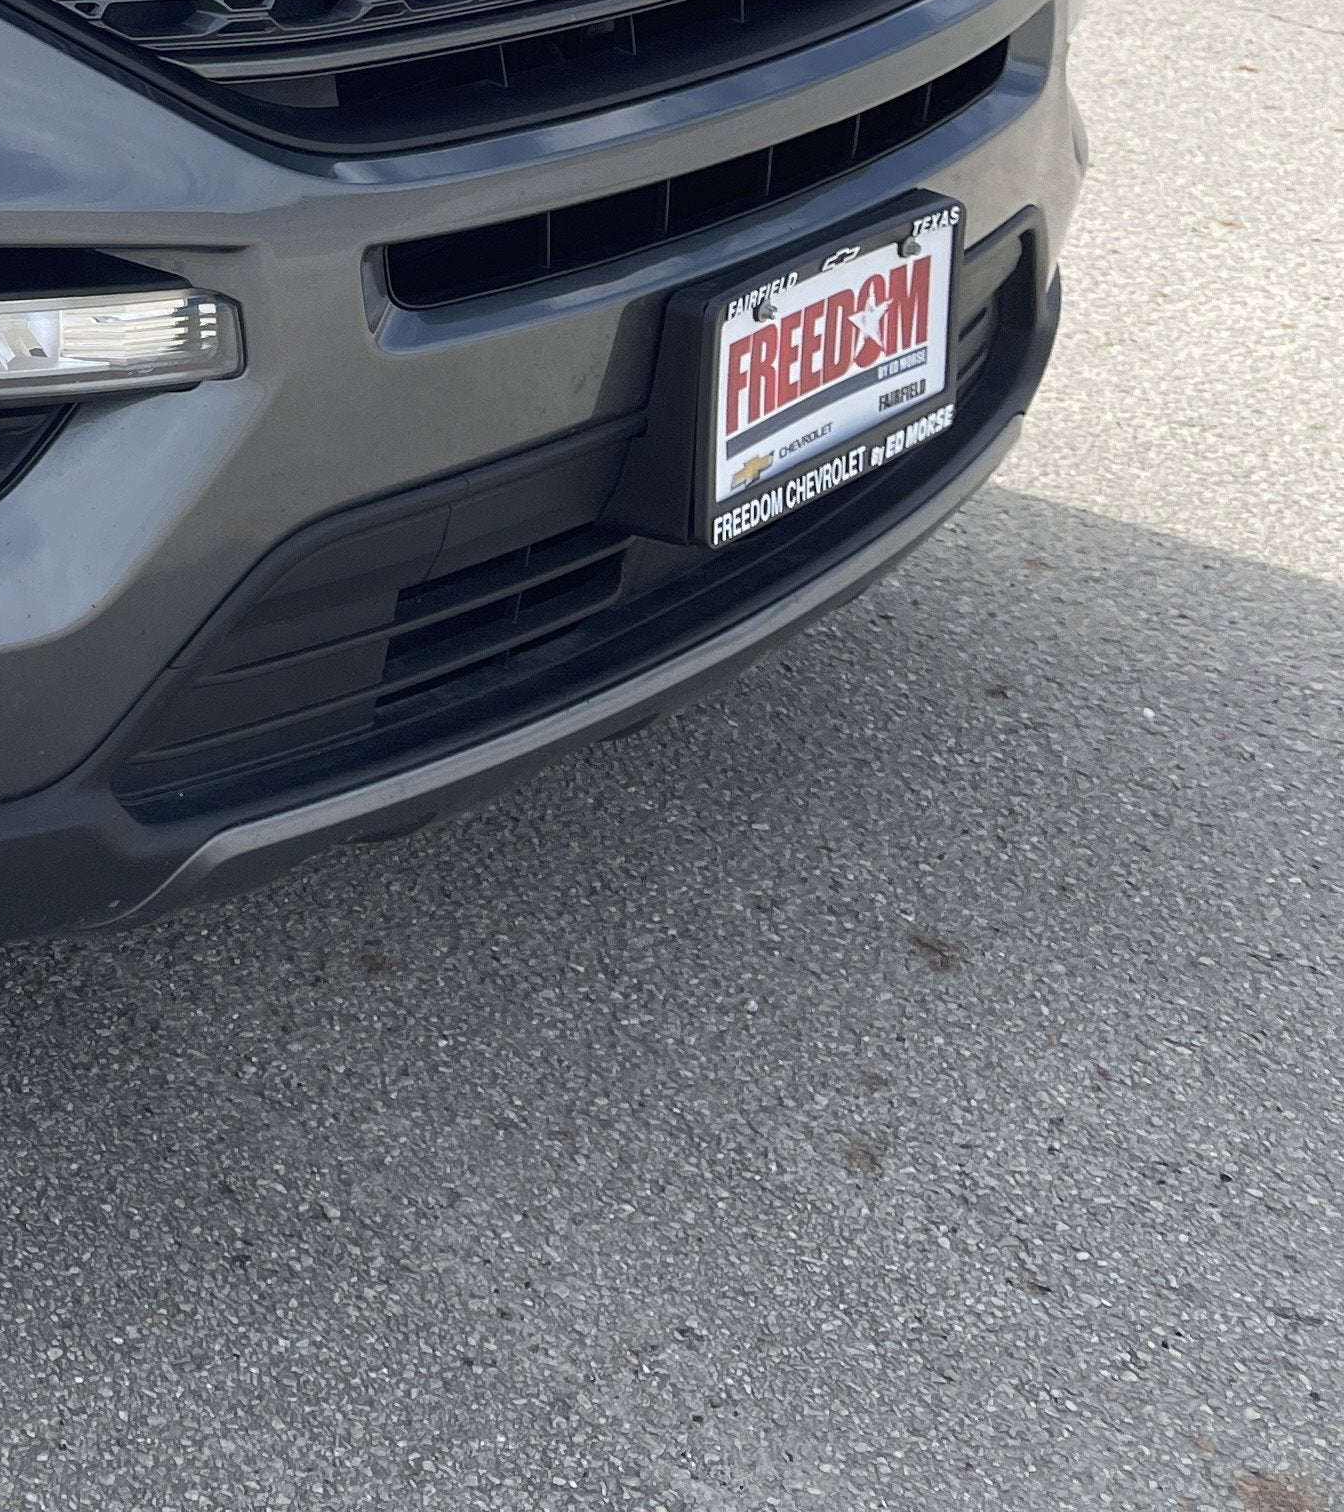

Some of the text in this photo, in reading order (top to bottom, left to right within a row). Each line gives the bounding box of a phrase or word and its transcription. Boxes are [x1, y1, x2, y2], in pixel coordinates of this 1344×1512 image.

[912, 205, 961, 237] TEXAS
[727, 272, 799, 320] FAIRFIELD
[726, 255, 932, 437] FREEDOM
[878, 378, 927, 413] FAIRFIELD
[778, 421, 834, 460] CHEVROLET
[713, 486, 784, 546] FREEDOM
[785, 445, 867, 510] CHEVROLET
[885, 429, 905, 459] ED
[905, 403, 955, 449] MORSE
